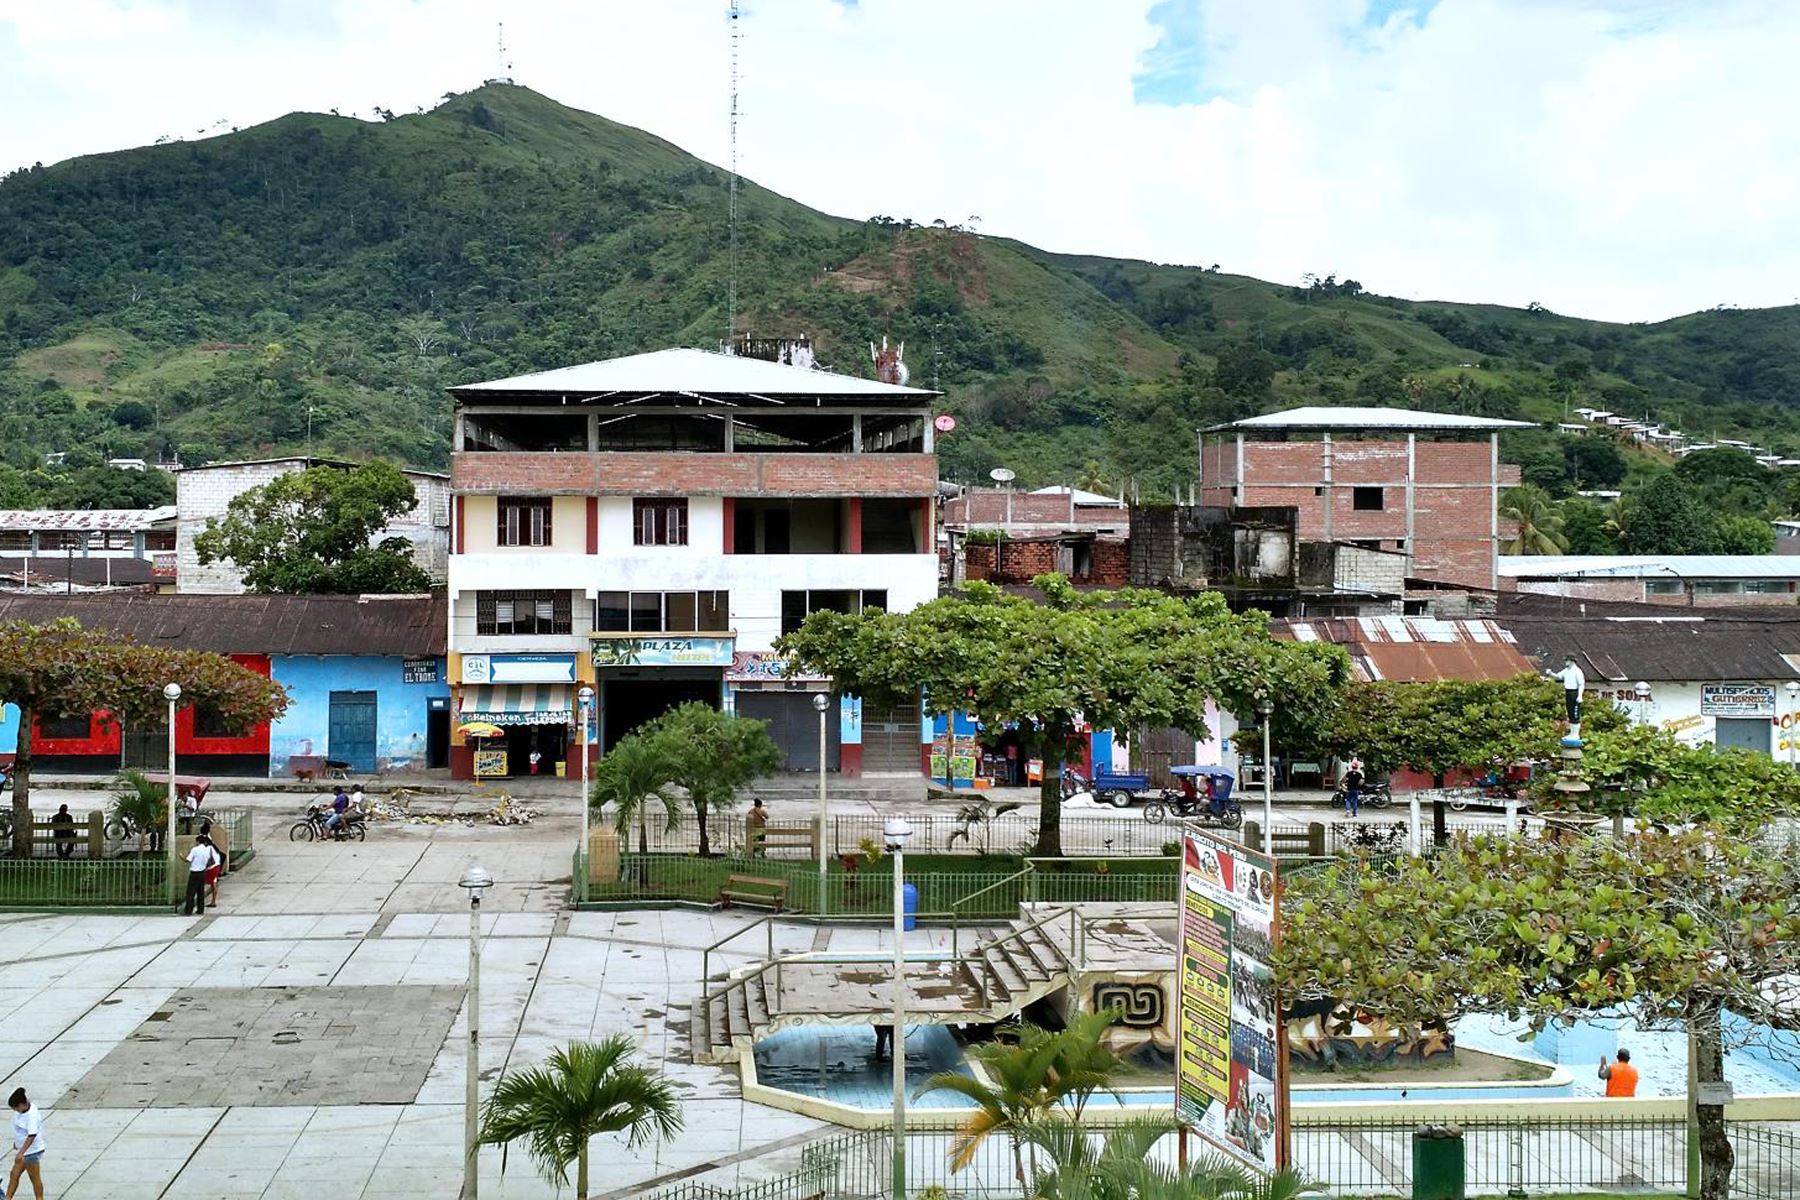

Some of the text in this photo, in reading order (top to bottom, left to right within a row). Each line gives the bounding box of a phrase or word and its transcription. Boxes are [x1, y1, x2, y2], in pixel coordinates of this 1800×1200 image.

[642, 641, 693, 652] PLAZA
[1712, 695, 1766, 704] GUTIERREZ
[473, 713, 522, 723] Heineken
